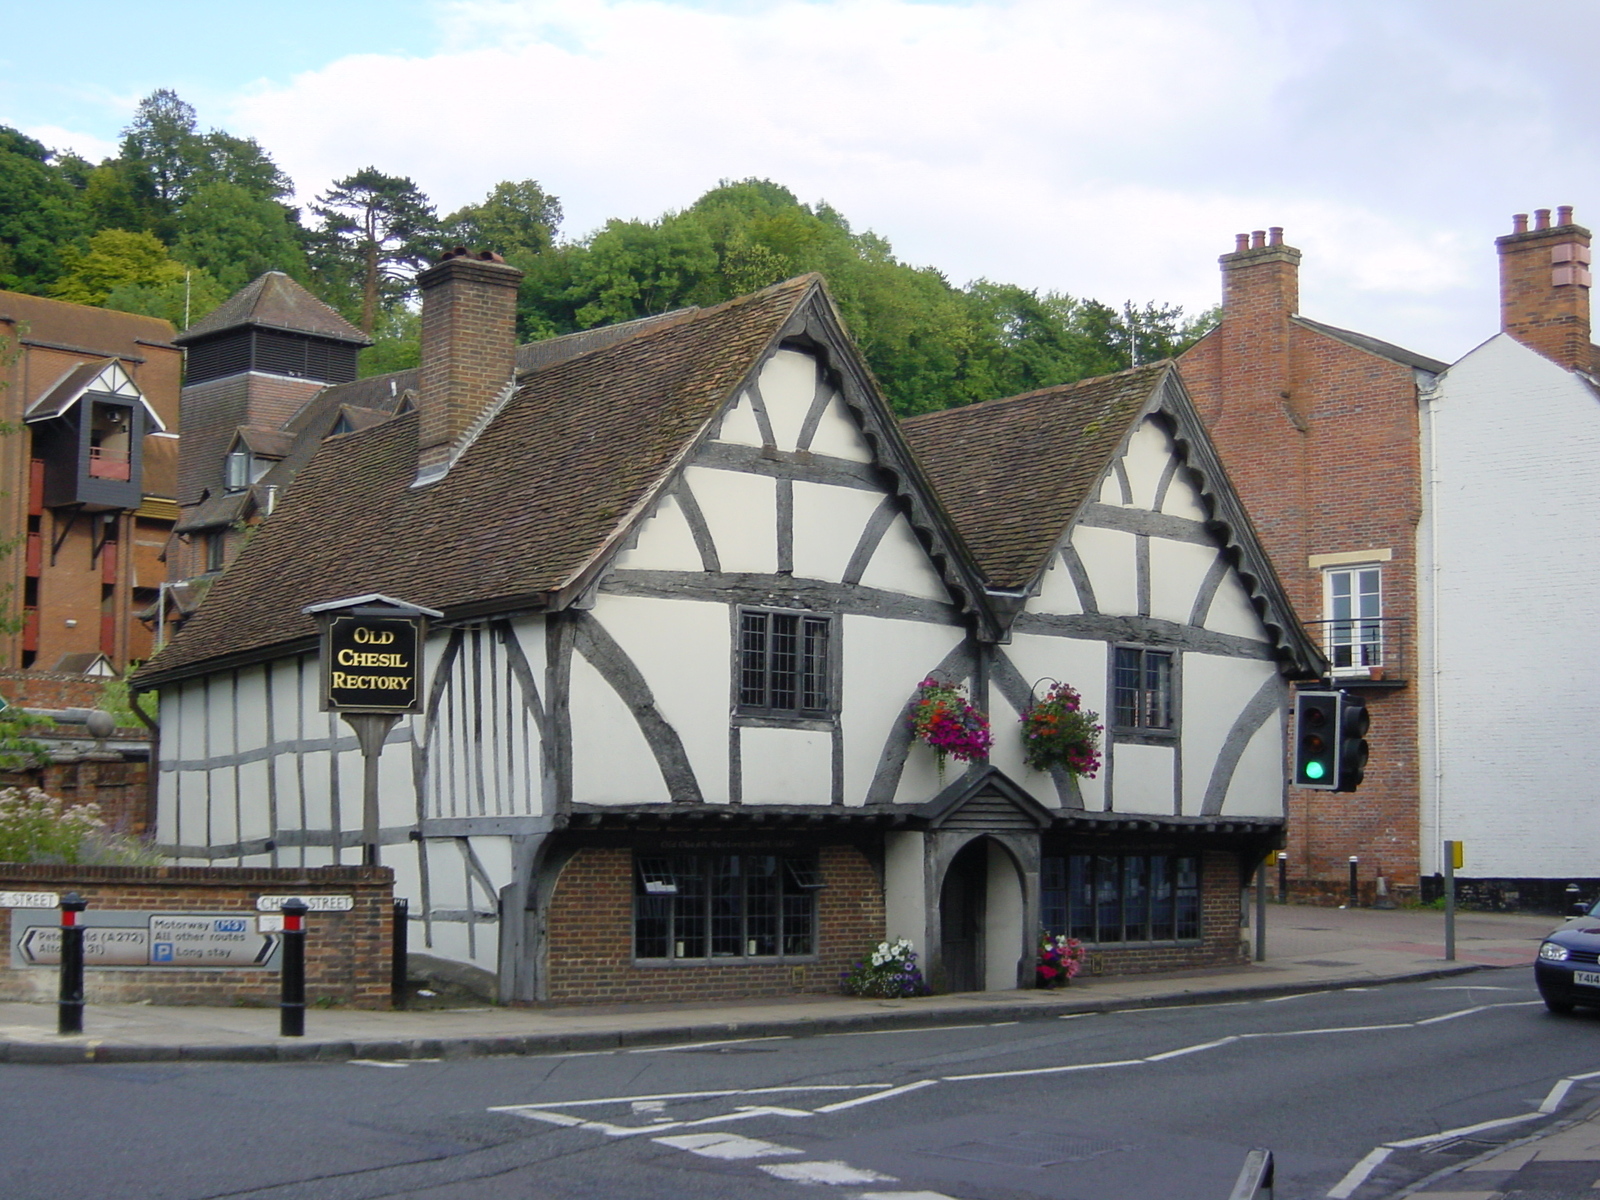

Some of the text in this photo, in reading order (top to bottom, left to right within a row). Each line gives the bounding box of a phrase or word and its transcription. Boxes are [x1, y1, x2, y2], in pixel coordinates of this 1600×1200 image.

[353, 626, 395, 645] OLD
[337, 648, 409, 668] CHESIL
[332, 671, 413, 690] RECTORY
[12, 893, 55, 907] STREET
[308, 897, 350, 909] STREET
[154, 920, 245, 931] Motorway (M3)
[101, 932, 145, 945] (A272)
[154, 932, 246, 942] All other routes
[176, 947, 203, 958] Long
[207, 948, 232, 958] stay
